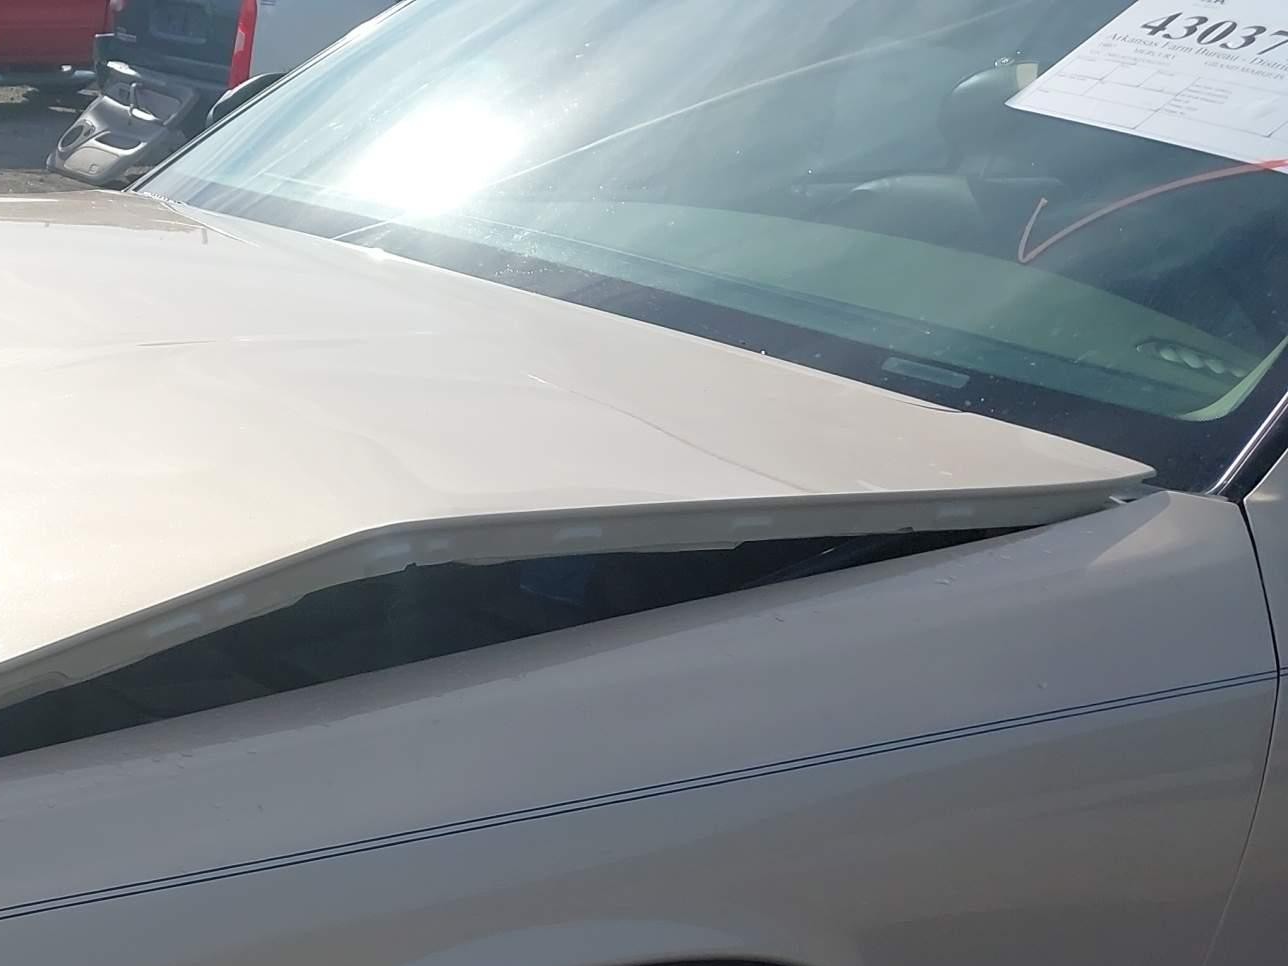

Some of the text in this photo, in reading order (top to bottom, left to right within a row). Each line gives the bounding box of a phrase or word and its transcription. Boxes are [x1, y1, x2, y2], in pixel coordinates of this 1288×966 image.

[1111, 33, 1159, 48] Arkansas
[1160, 40, 1194, 54] Farm
[1140, 11, 1288, 55] 43037
